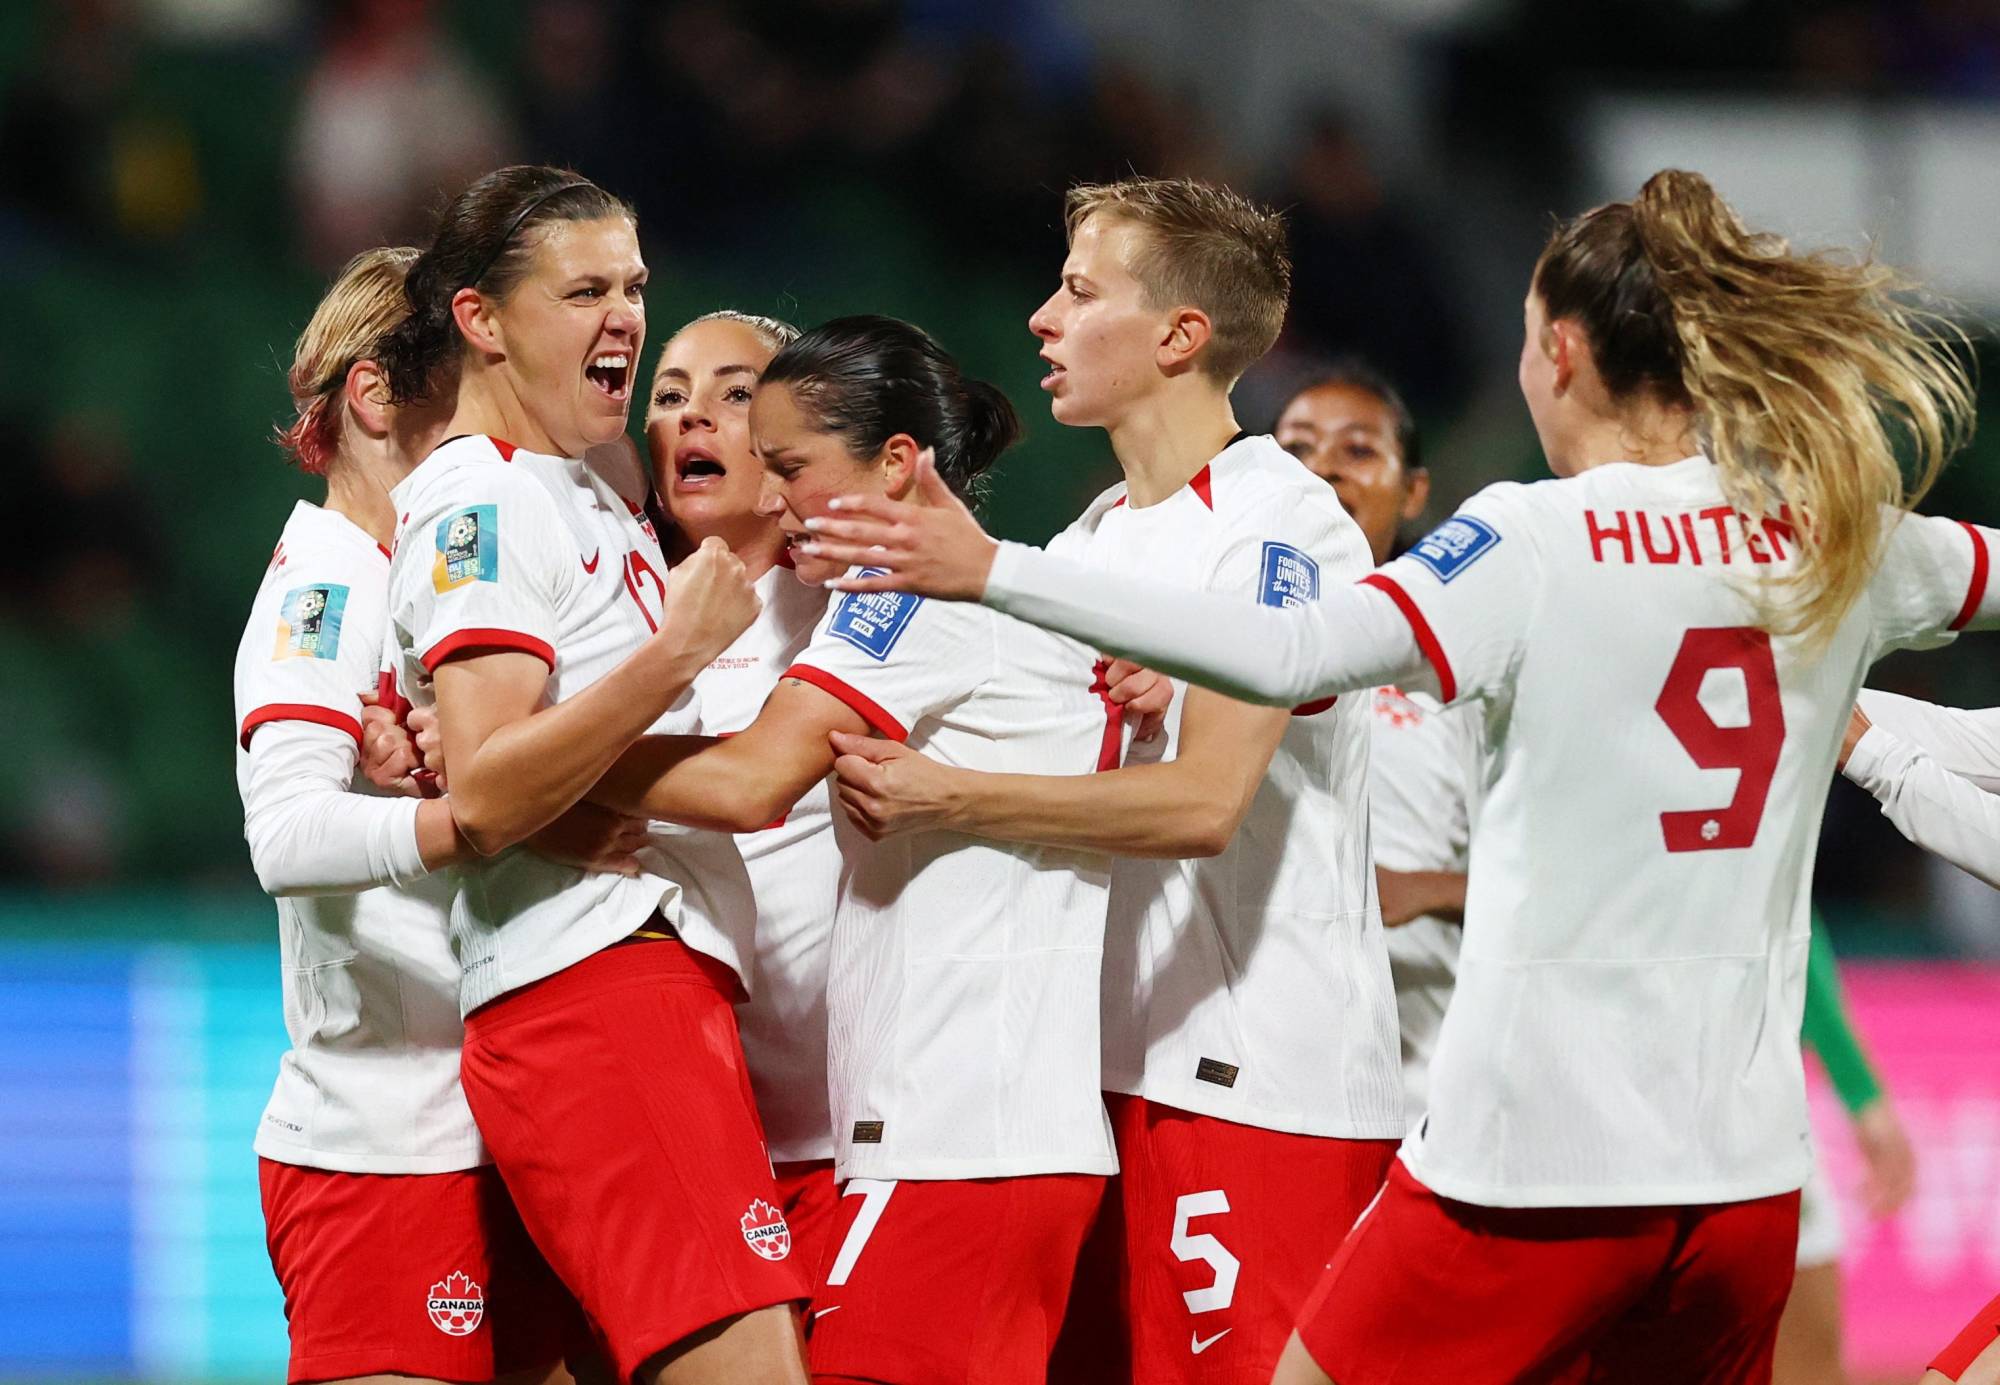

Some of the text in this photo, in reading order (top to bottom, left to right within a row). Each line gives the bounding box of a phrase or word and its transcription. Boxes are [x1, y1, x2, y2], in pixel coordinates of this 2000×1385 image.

[1272, 580, 1289, 592] the
[1276, 566, 1312, 592] UNITES
[848, 601, 863, 614] the
[856, 592, 899, 619] UNITES
[853, 620, 871, 633] FIFA
[1654, 626, 1787, 853] 9
[745, 1223, 787, 1241] CANADA
[825, 1177, 899, 1287] 7
[1169, 1189, 1241, 1315] 5
[428, 1300, 482, 1310] CANADA
